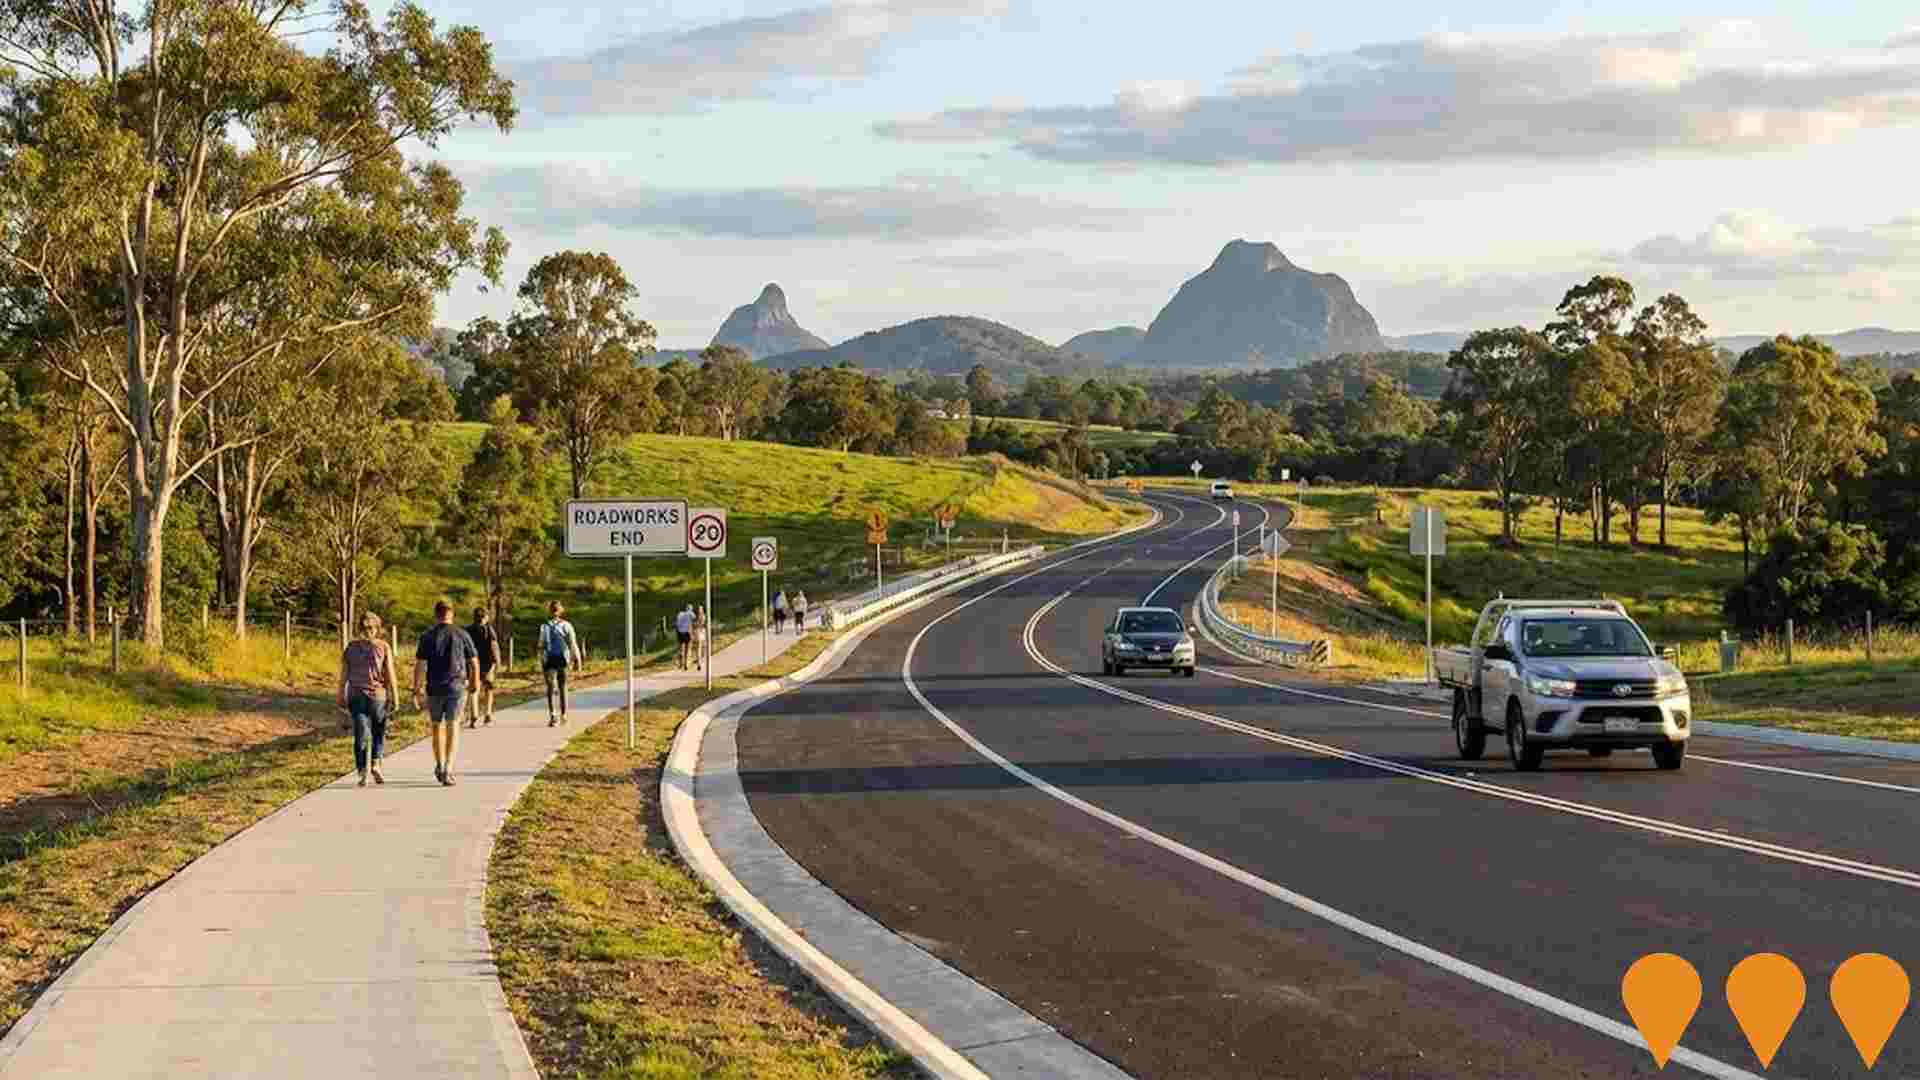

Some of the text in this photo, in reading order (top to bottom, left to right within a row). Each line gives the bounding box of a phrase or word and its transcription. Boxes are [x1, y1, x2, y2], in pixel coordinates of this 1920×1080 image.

[575, 509, 679, 524] ROADWORKS
[611, 531, 644, 546] END
[695, 525, 720, 541] 20
